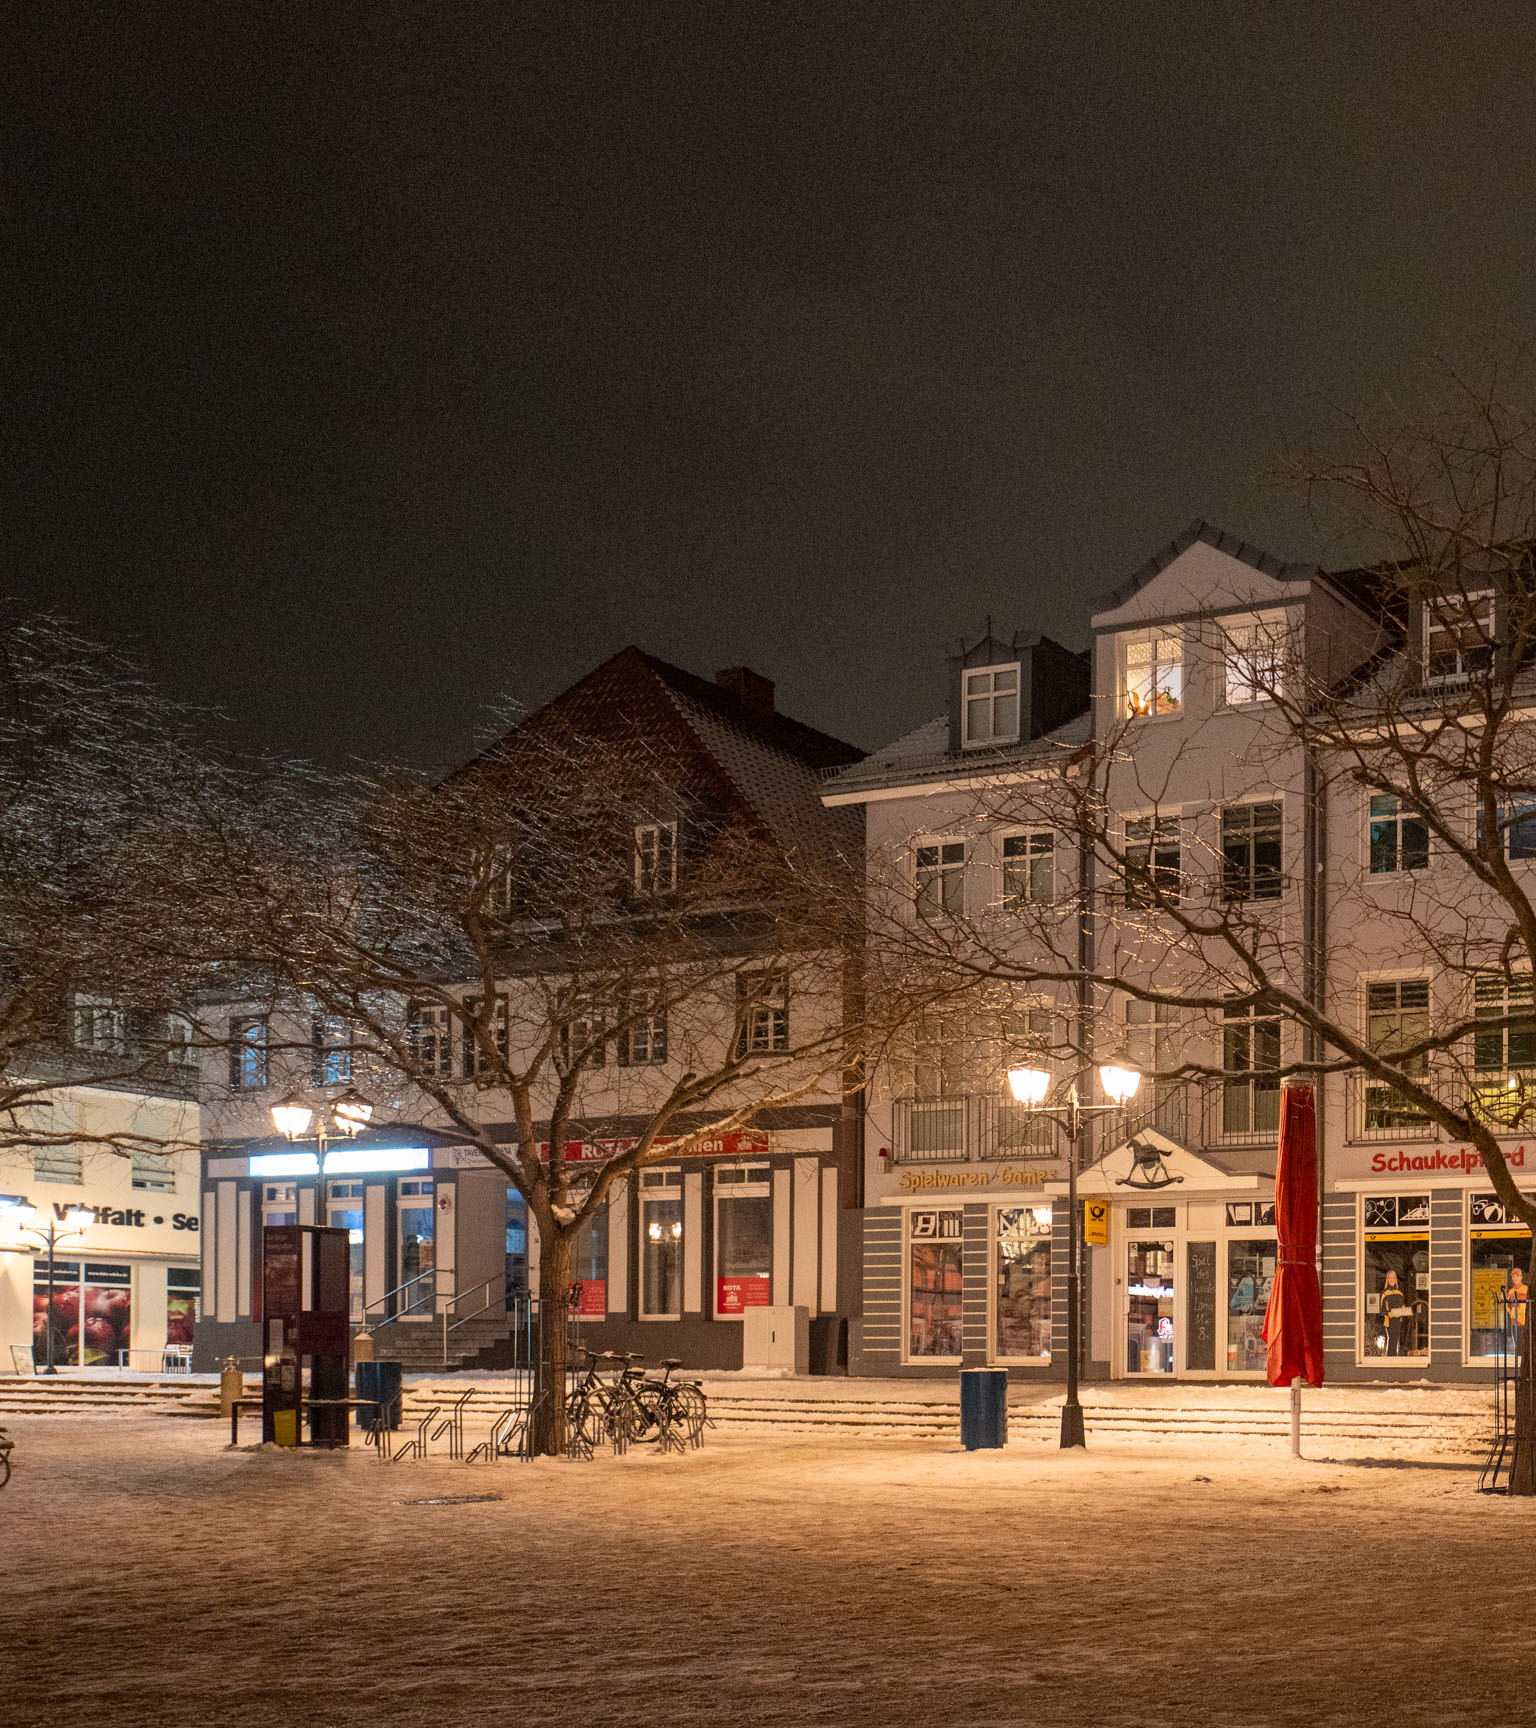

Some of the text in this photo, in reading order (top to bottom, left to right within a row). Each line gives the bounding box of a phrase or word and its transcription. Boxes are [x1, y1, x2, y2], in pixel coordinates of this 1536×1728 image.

[900, 1166, 1058, 1193] Spielwaren Games
[52, 1202, 146, 1227] Vlfalt
